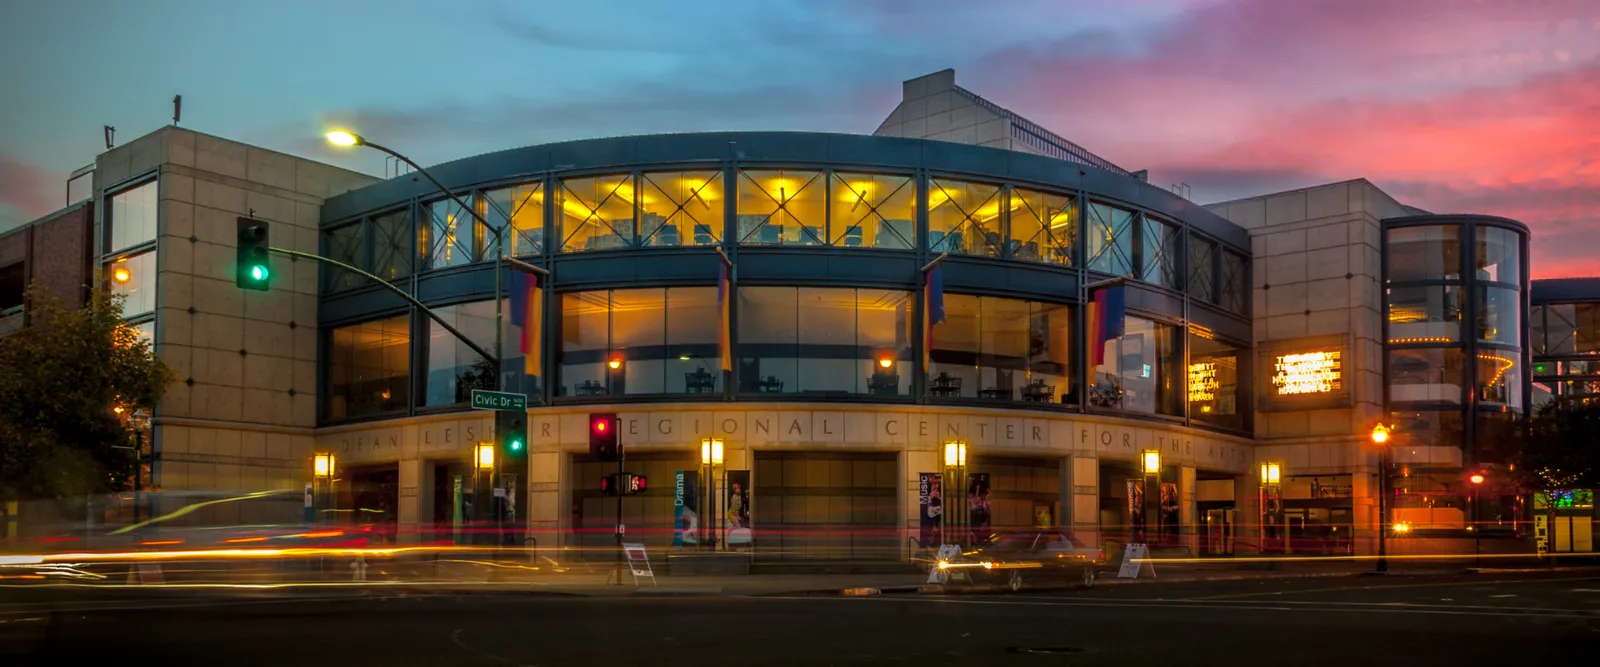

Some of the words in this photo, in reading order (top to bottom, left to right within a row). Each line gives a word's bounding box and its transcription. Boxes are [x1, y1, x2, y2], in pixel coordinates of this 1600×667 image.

[475, 394, 498, 406] Civic
[500, 396, 511, 407] Dr
[341, 434, 398, 453] DEAN
[629, 418, 833, 435] EGIONAL
[885, 420, 1042, 441] CENTER
[1081, 429, 1131, 448] FOR
[1158, 437, 1191, 455] THE
[1208, 445, 1246, 464] ARTS
[675, 473, 685, 507] Drama
[920, 475, 929, 505] Music
